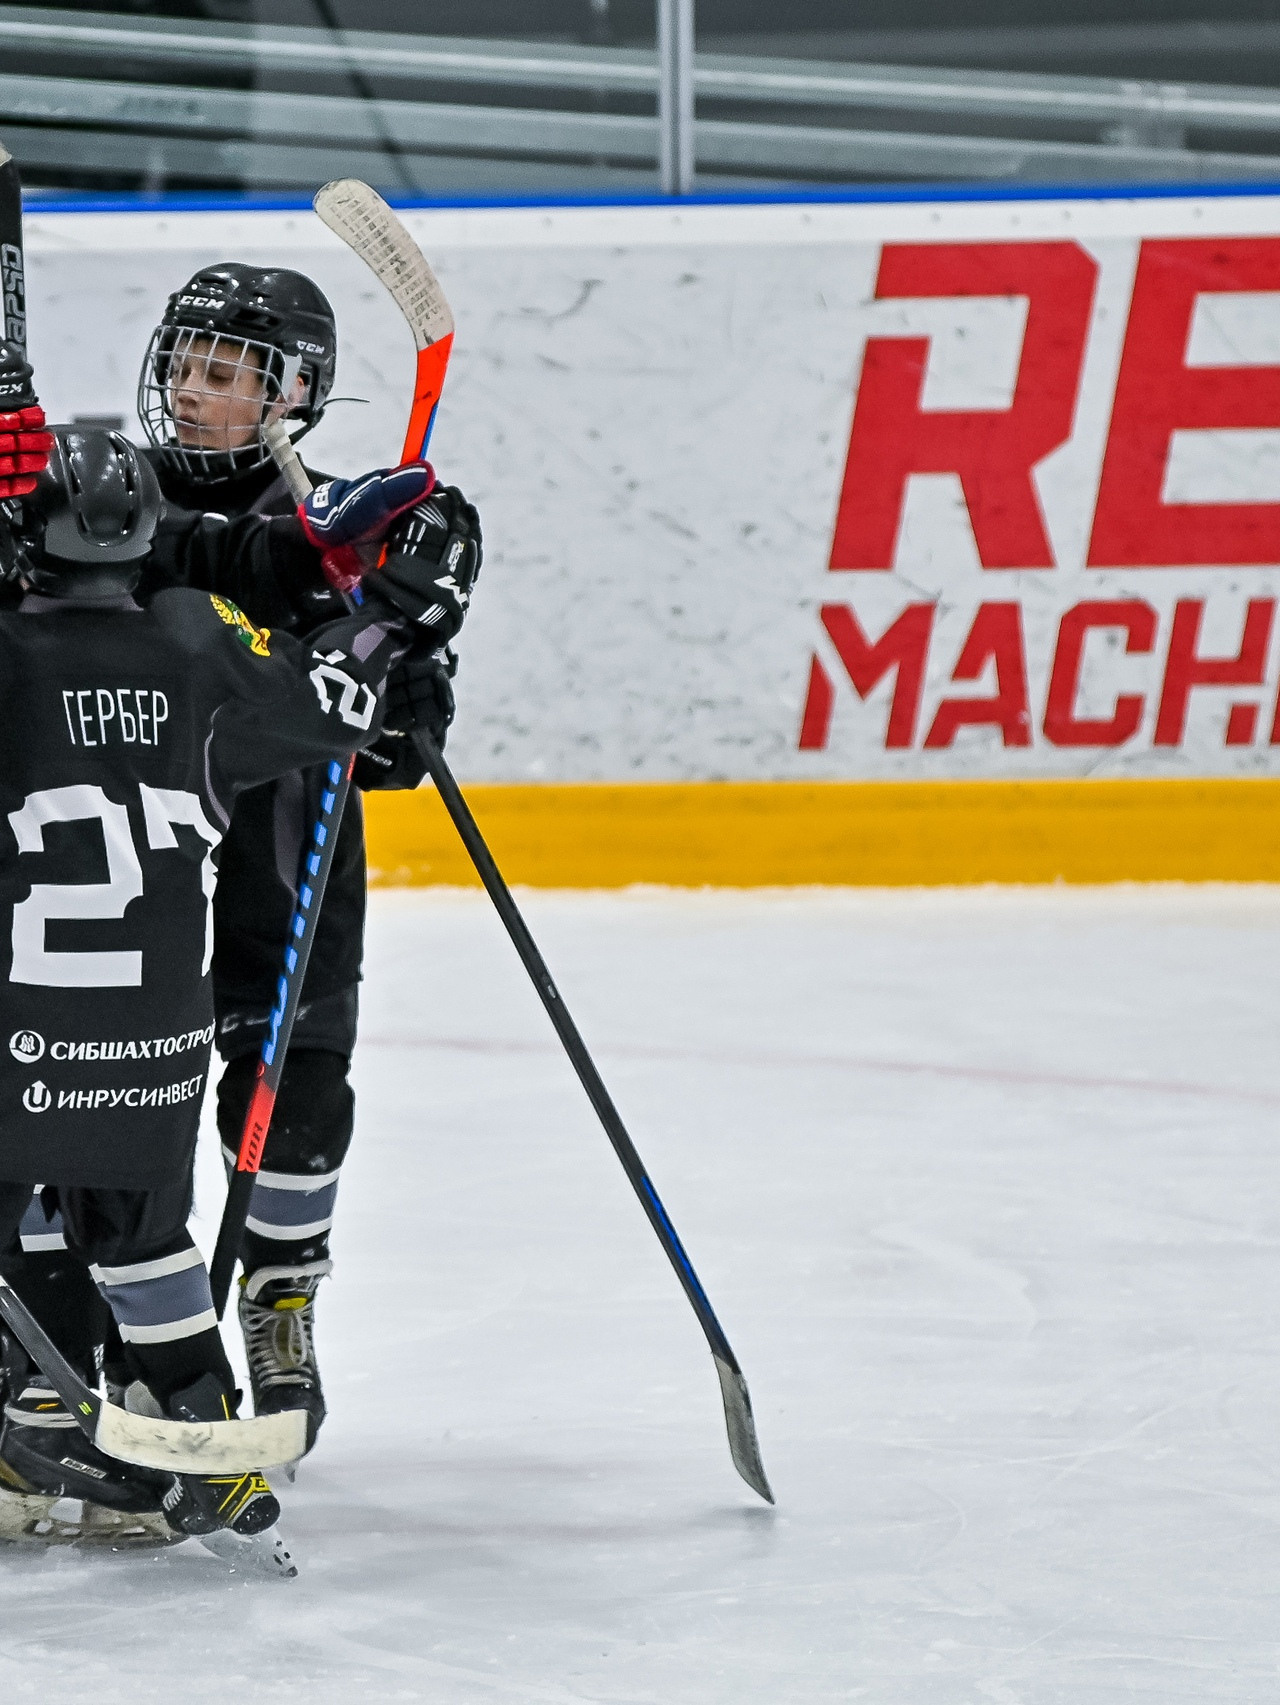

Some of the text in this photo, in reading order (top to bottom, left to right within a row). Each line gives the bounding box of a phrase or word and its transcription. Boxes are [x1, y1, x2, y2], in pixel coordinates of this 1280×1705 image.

[180, 295, 225, 310] CCM
[296, 340, 325, 354] CCM
[799, 596, 1280, 752] MACH
[62, 688, 169, 746] ГЕРБЕР
[8, 782, 223, 988] 27
[57, 1074, 203, 1109] ИНРУСИНВЕСТ
